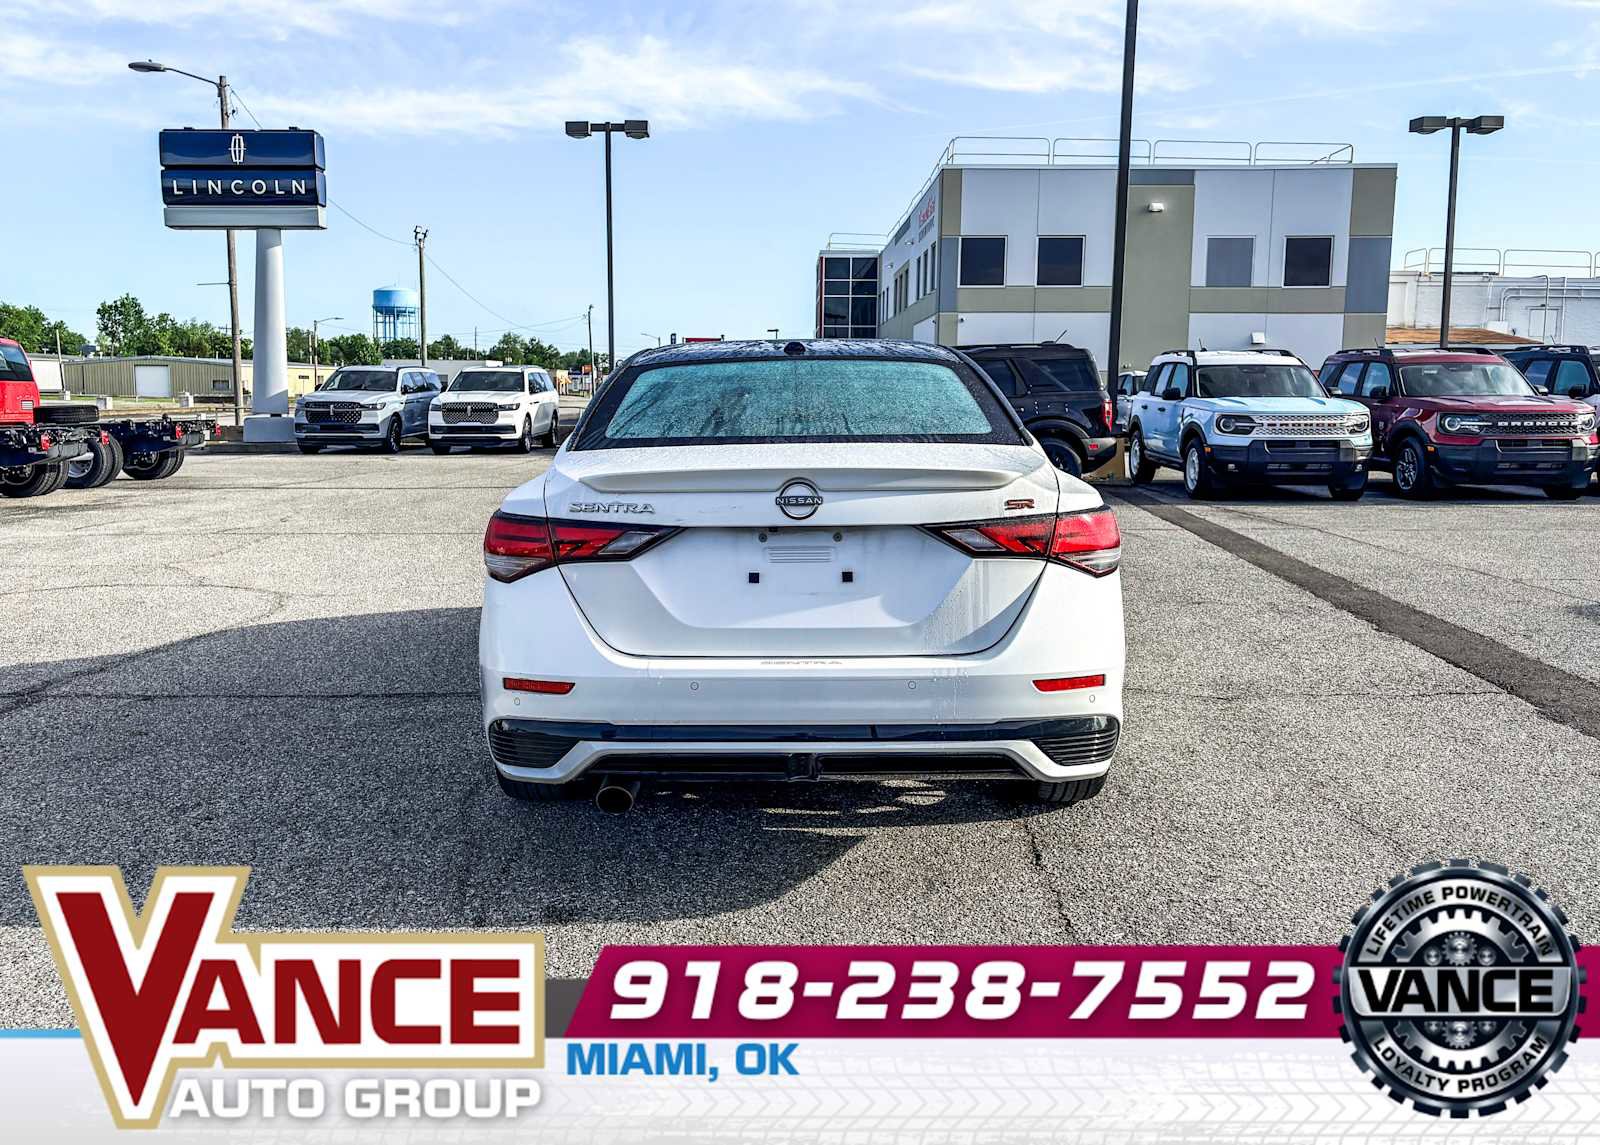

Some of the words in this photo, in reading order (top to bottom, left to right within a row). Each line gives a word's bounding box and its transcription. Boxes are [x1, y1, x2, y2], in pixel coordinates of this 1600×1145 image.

[172, 179, 306, 195] LINCOLN
[776, 497, 822, 505] NISSAN
[1004, 499, 1035, 510] SR
[569, 502, 655, 514] SENTRA
